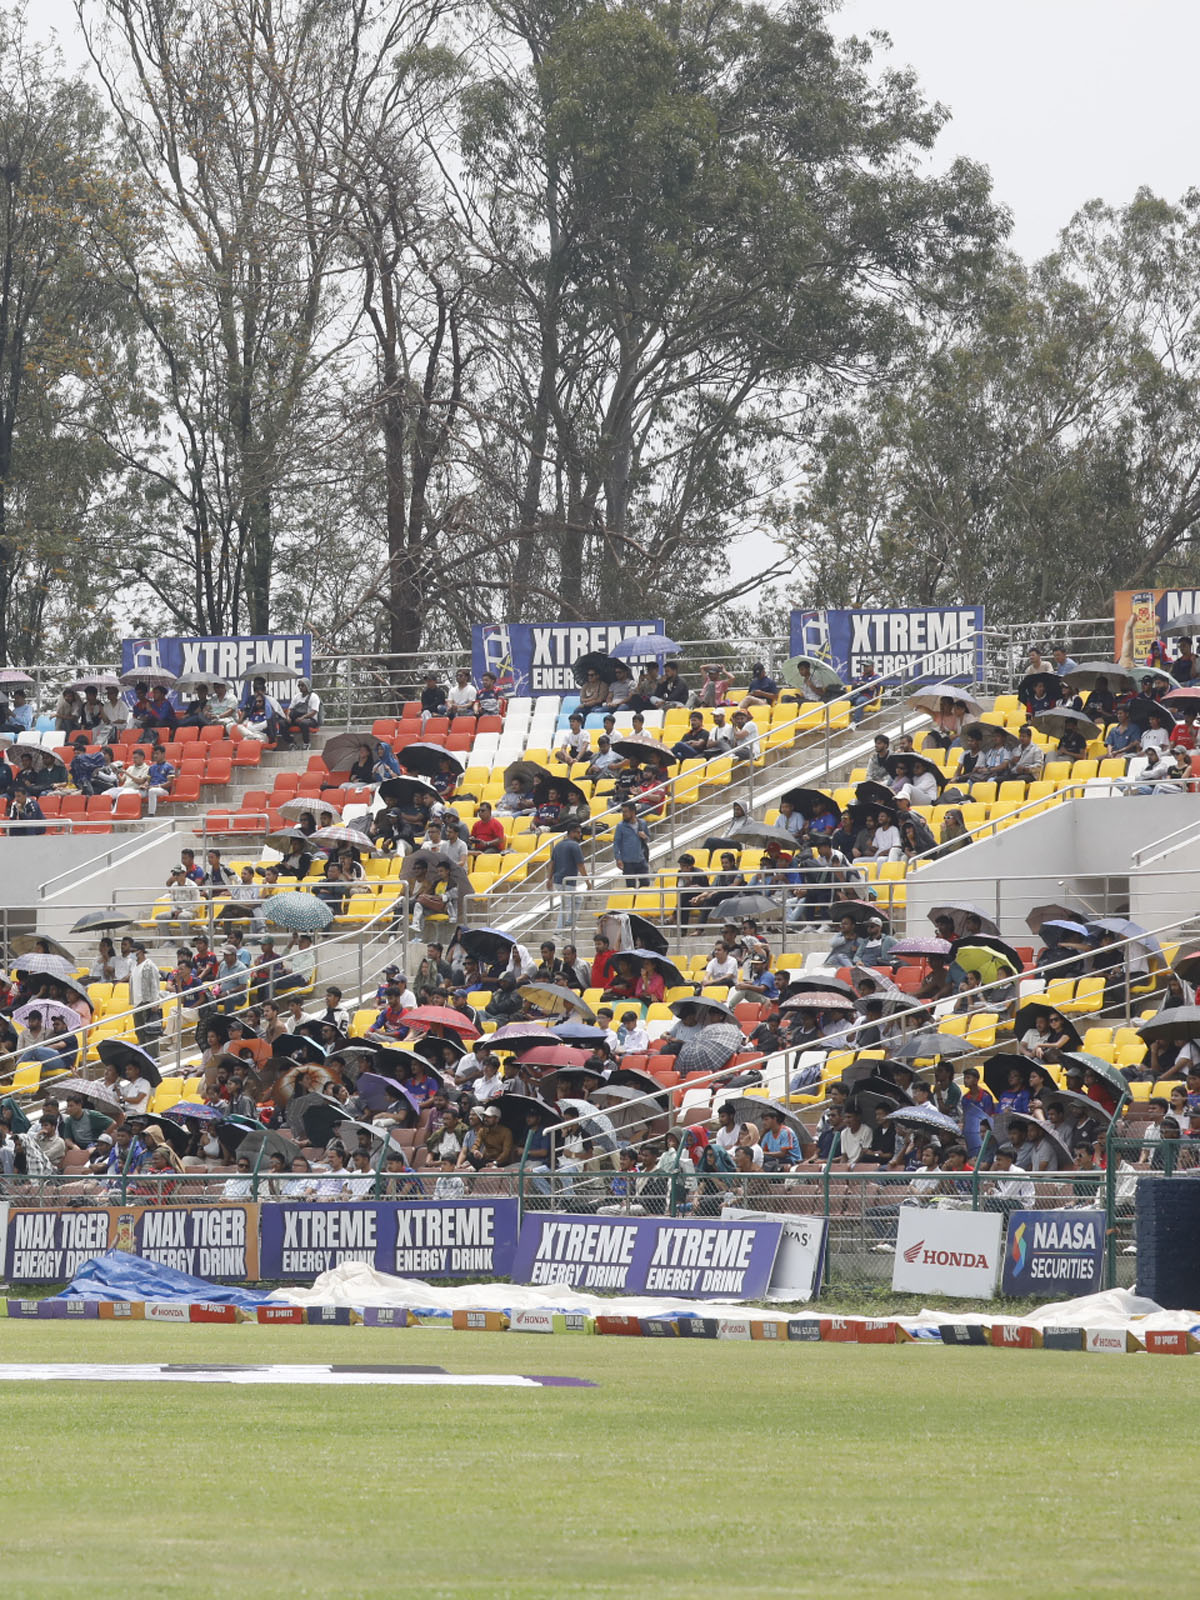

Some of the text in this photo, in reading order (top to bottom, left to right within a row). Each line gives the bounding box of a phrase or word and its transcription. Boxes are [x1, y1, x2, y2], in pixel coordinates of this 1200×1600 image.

[851, 611, 975, 653] XTREME
[922, 652, 974, 676] DRINK
[532, 667, 583, 690] ENER
[14, 1209, 247, 1249] MAX TIGER MAX TIGER
[282, 1207, 494, 1248] XTREME XTREME
[1033, 1222, 1096, 1249] NAASA
[535, 1222, 756, 1268] XTREME XTREME
[12, 1250, 63, 1279] ENERGY
[199, 1247, 247, 1277] DRINK
[282, 1250, 331, 1272] ENERGY
[396, 1249, 448, 1272] ENERGY
[451, 1248, 494, 1271] DRINK
[923, 1249, 990, 1269] HONDA
[1030, 1258, 1095, 1280] SECURITIES
[531, 1261, 746, 1293] ENERGY DRINK ENERGY DRINK
[158, 1309, 185, 1317] HONDA
[524, 1315, 550, 1324] HONDA
